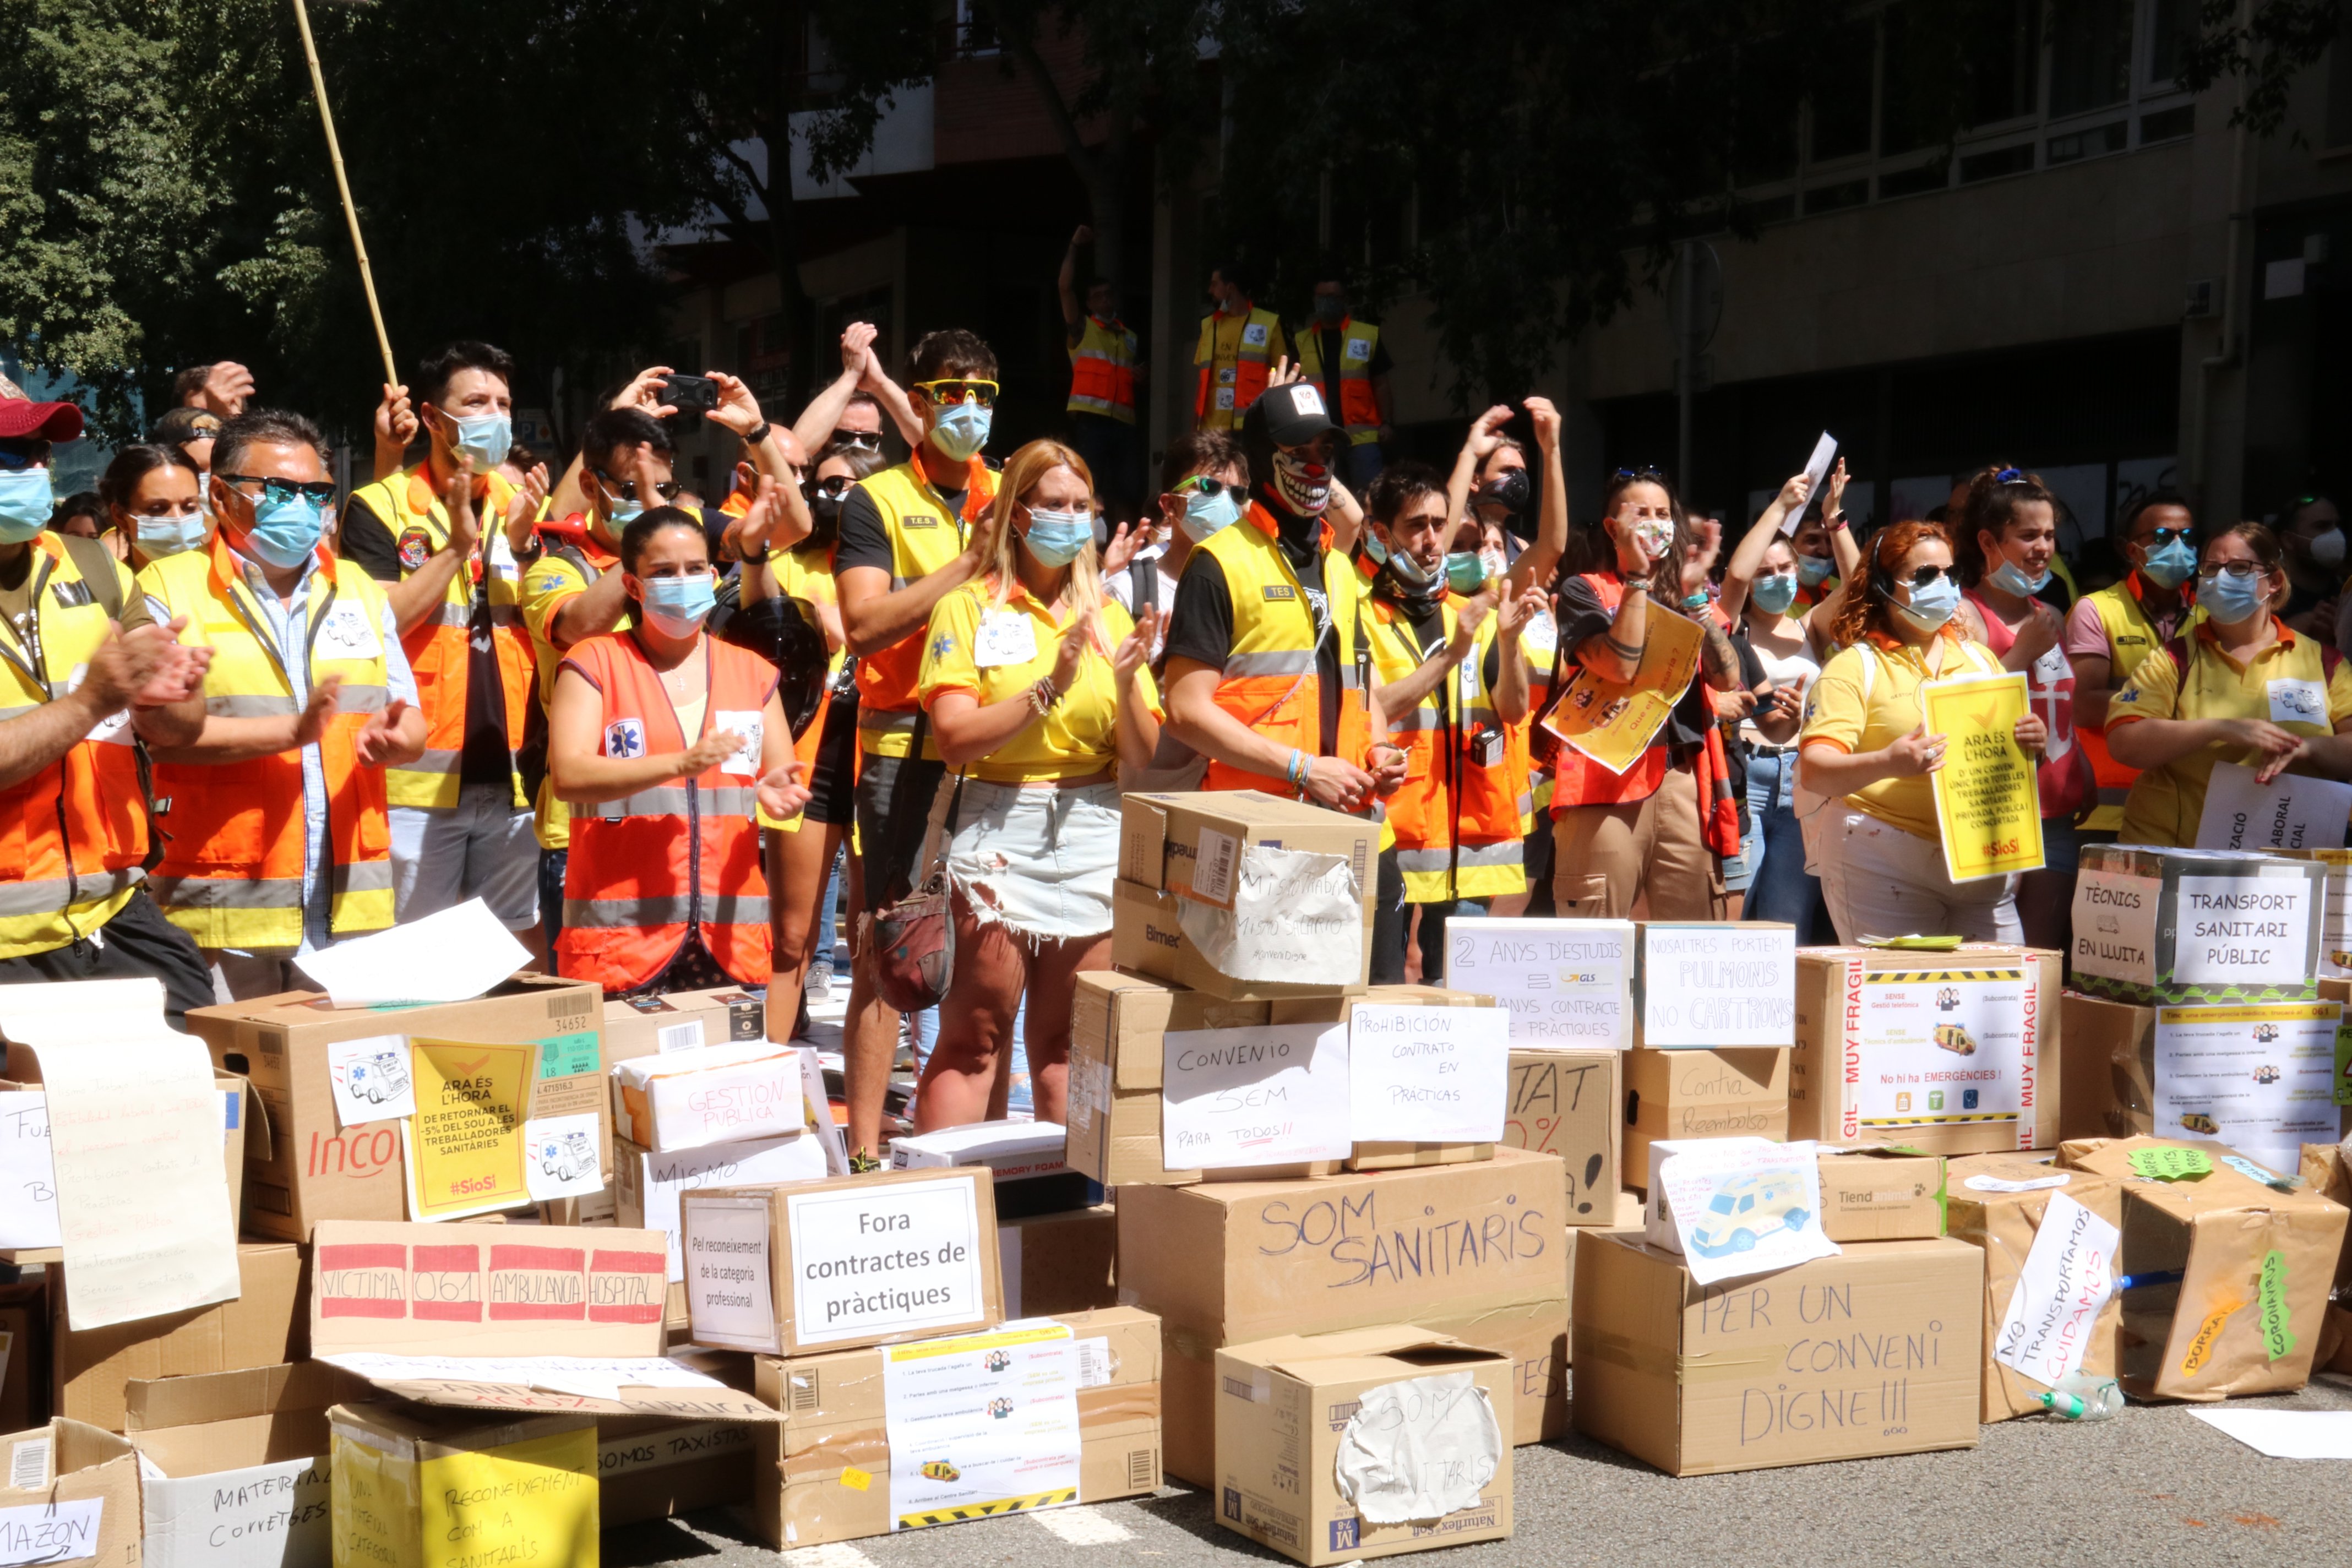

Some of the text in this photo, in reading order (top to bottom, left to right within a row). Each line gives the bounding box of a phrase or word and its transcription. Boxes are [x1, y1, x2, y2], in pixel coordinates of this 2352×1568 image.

[1271, 587, 1289, 597] TES
[1964, 732, 2006, 747] ARA ÉS
[1964, 745, 2007, 761] L'HORA
[1973, 776, 1989, 785] PER
[2012, 771, 2025, 780] LES
[1984, 762, 2015, 774] CONVENI
[2086, 881, 2141, 909] TÈCNICS
[2190, 894, 2297, 910] TRANSPORT
[2195, 922, 2288, 938] SANITARI
[1455, 937, 1623, 967] 2 ANYS D'ESTUDIS
[1652, 937, 1782, 955] NOSALTRES PORTEM
[2078, 939, 2146, 965] EN LLUITA
[2207, 944, 2271, 965] PÚBLIC
[1580, 974, 1596, 982] GLS
[1680, 960, 1779, 988] PULMONS
[1499, 997, 1620, 1014] ANYS CONTRACTE
[1847, 960, 1861, 1031] FRAGIL
[556, 1016, 586, 1032] 34652
[1653, 997, 1794, 1030] NO CARTRONS
[2023, 982, 2036, 1057] FRAGIL
[1529, 1017, 1611, 1037] PRÀCTIQUES
[1439, 1062, 1460, 1074] EN
[1845, 1039, 1859, 1083] MUY
[442, 1077, 493, 1093] ARA ÉS
[1680, 1069, 1751, 1096] Contra
[1880, 1069, 1995, 1084] No hi ha EMERGÈNCIES
[2022, 1064, 2034, 1106] MUY
[442, 1090, 491, 1106] L'HORA
[1207, 1086, 1288, 1113] SEM
[420, 1113, 515, 1135] -5% DEL SOU A LES
[424, 1104, 510, 1124] DE RETORNAR EL
[1683, 1107, 1768, 1134] Reembolso
[424, 1125, 512, 1146] TREBALLADORES
[440, 1137, 498, 1155] SANITÀRIES
[1177, 1132, 1211, 1148] PARA
[308, 1129, 403, 1178] Inco
[1035, 1161, 1064, 1171] FOAM
[859, 1210, 911, 1234] Fora
[1259, 1190, 1375, 1255] SOM
[693, 1237, 761, 1255] Pel reconeixement
[1327, 1195, 1544, 1287] SANITARIS
[805, 1242, 966, 1280] contractes de
[700, 1266, 755, 1283] de la categoria
[322, 1271, 656, 1305] VICTIMA 061 AMBULANCIA HOSPITAL
[2021, 1209, 2090, 1364] TRANSPORTAMOS
[706, 1291, 753, 1309] professional
[826, 1283, 952, 1322] pràctiques
[1702, 1283, 1852, 1334] PER UN
[2265, 1256, 2284, 1355] CORONAVIRUS
[2000, 1321, 2026, 1357] NO
[1380, 1390, 1453, 1431] SOM
[447, 1511, 513, 1541] COM A
